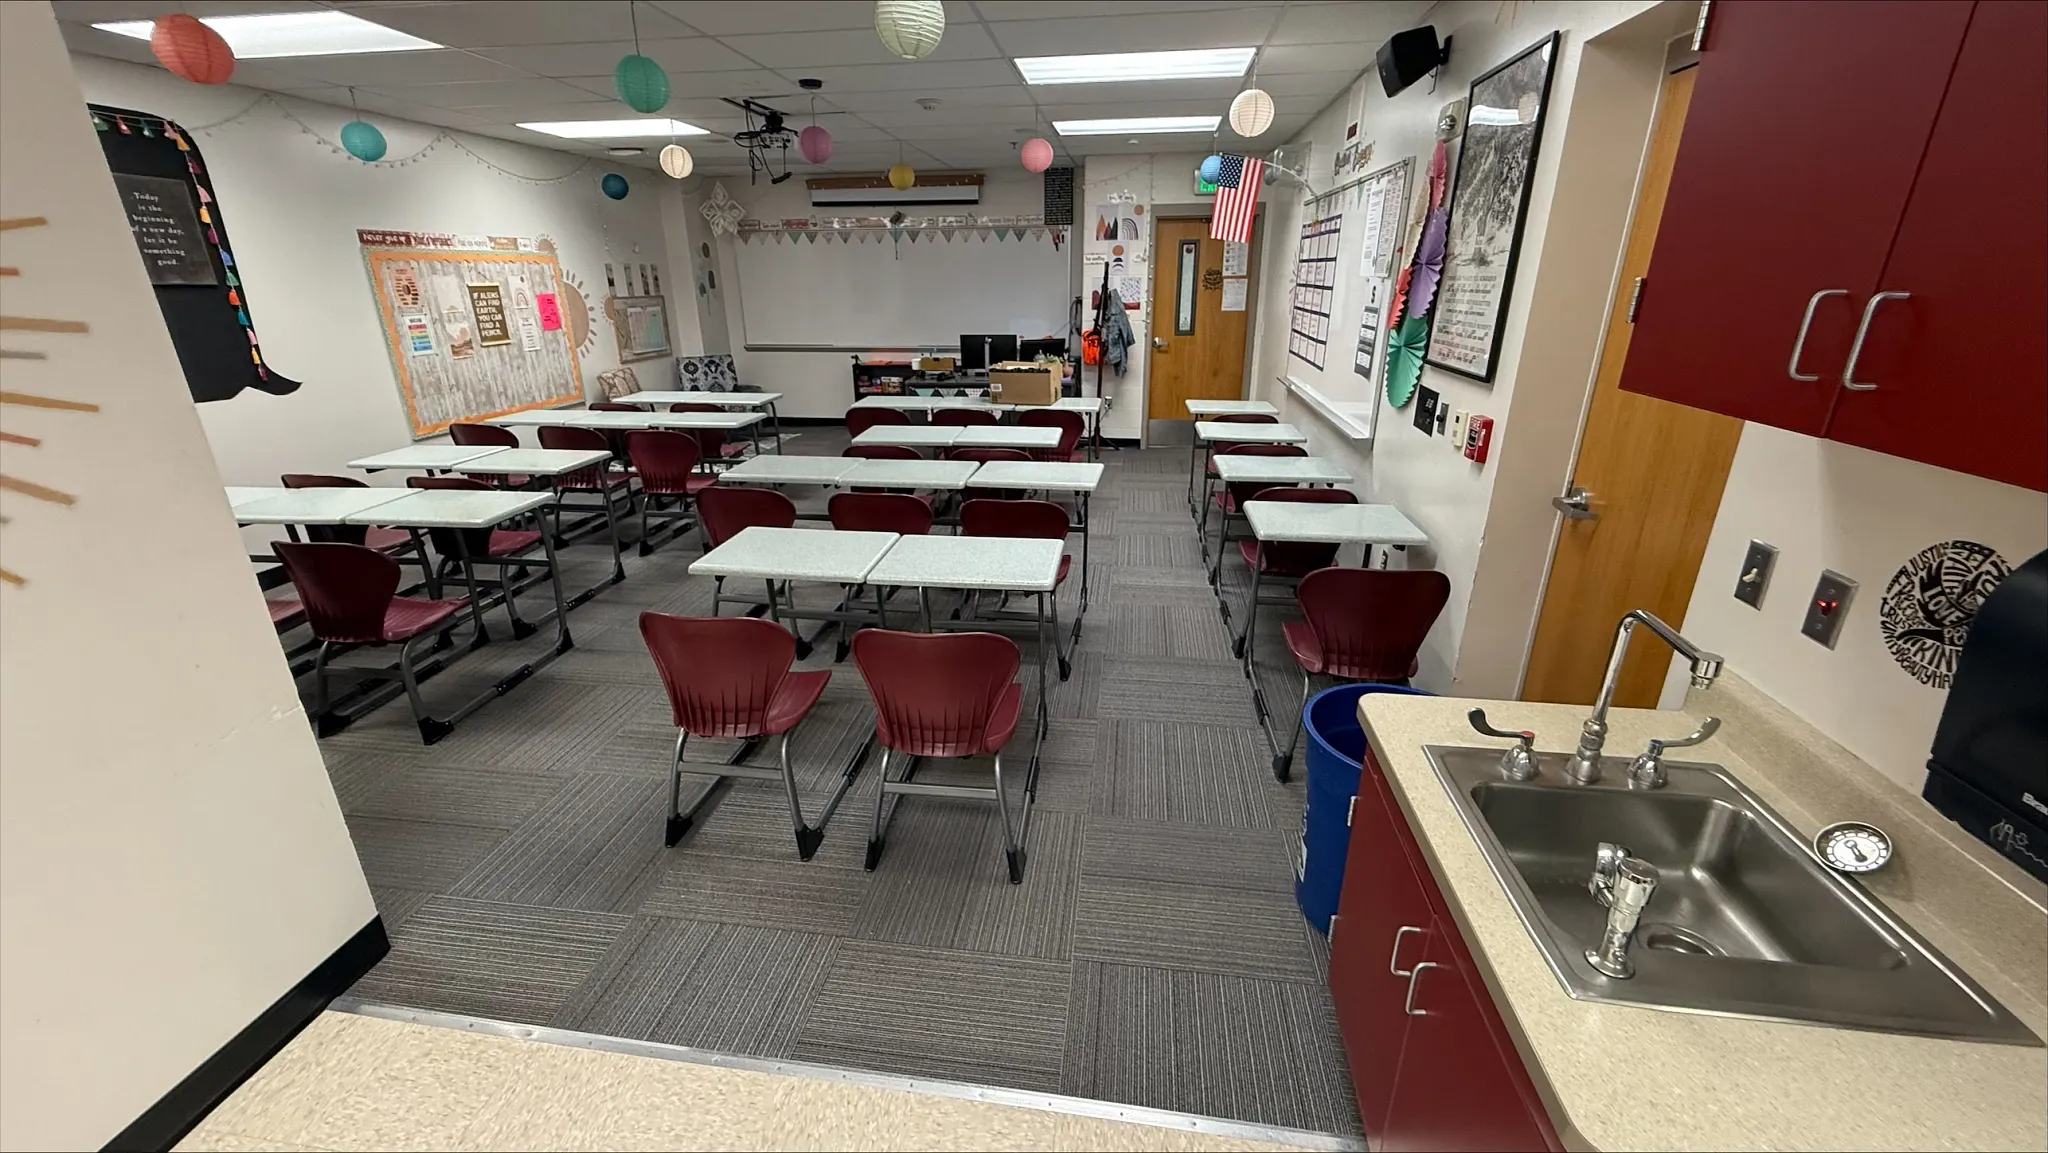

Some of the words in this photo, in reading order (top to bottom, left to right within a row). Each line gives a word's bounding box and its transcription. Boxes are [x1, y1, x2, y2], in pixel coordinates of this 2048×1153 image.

[133, 192, 158, 203] Today
[132, 214, 175, 224] beginning
[143, 248, 186, 256] something
[472, 292, 479, 300] IF
[480, 291, 499, 299] ALIENS
[477, 314, 491, 322] YOU
[491, 313, 503, 321] CAN
[480, 321, 494, 329] FIND
[1923, 585, 1966, 625] LOVE
